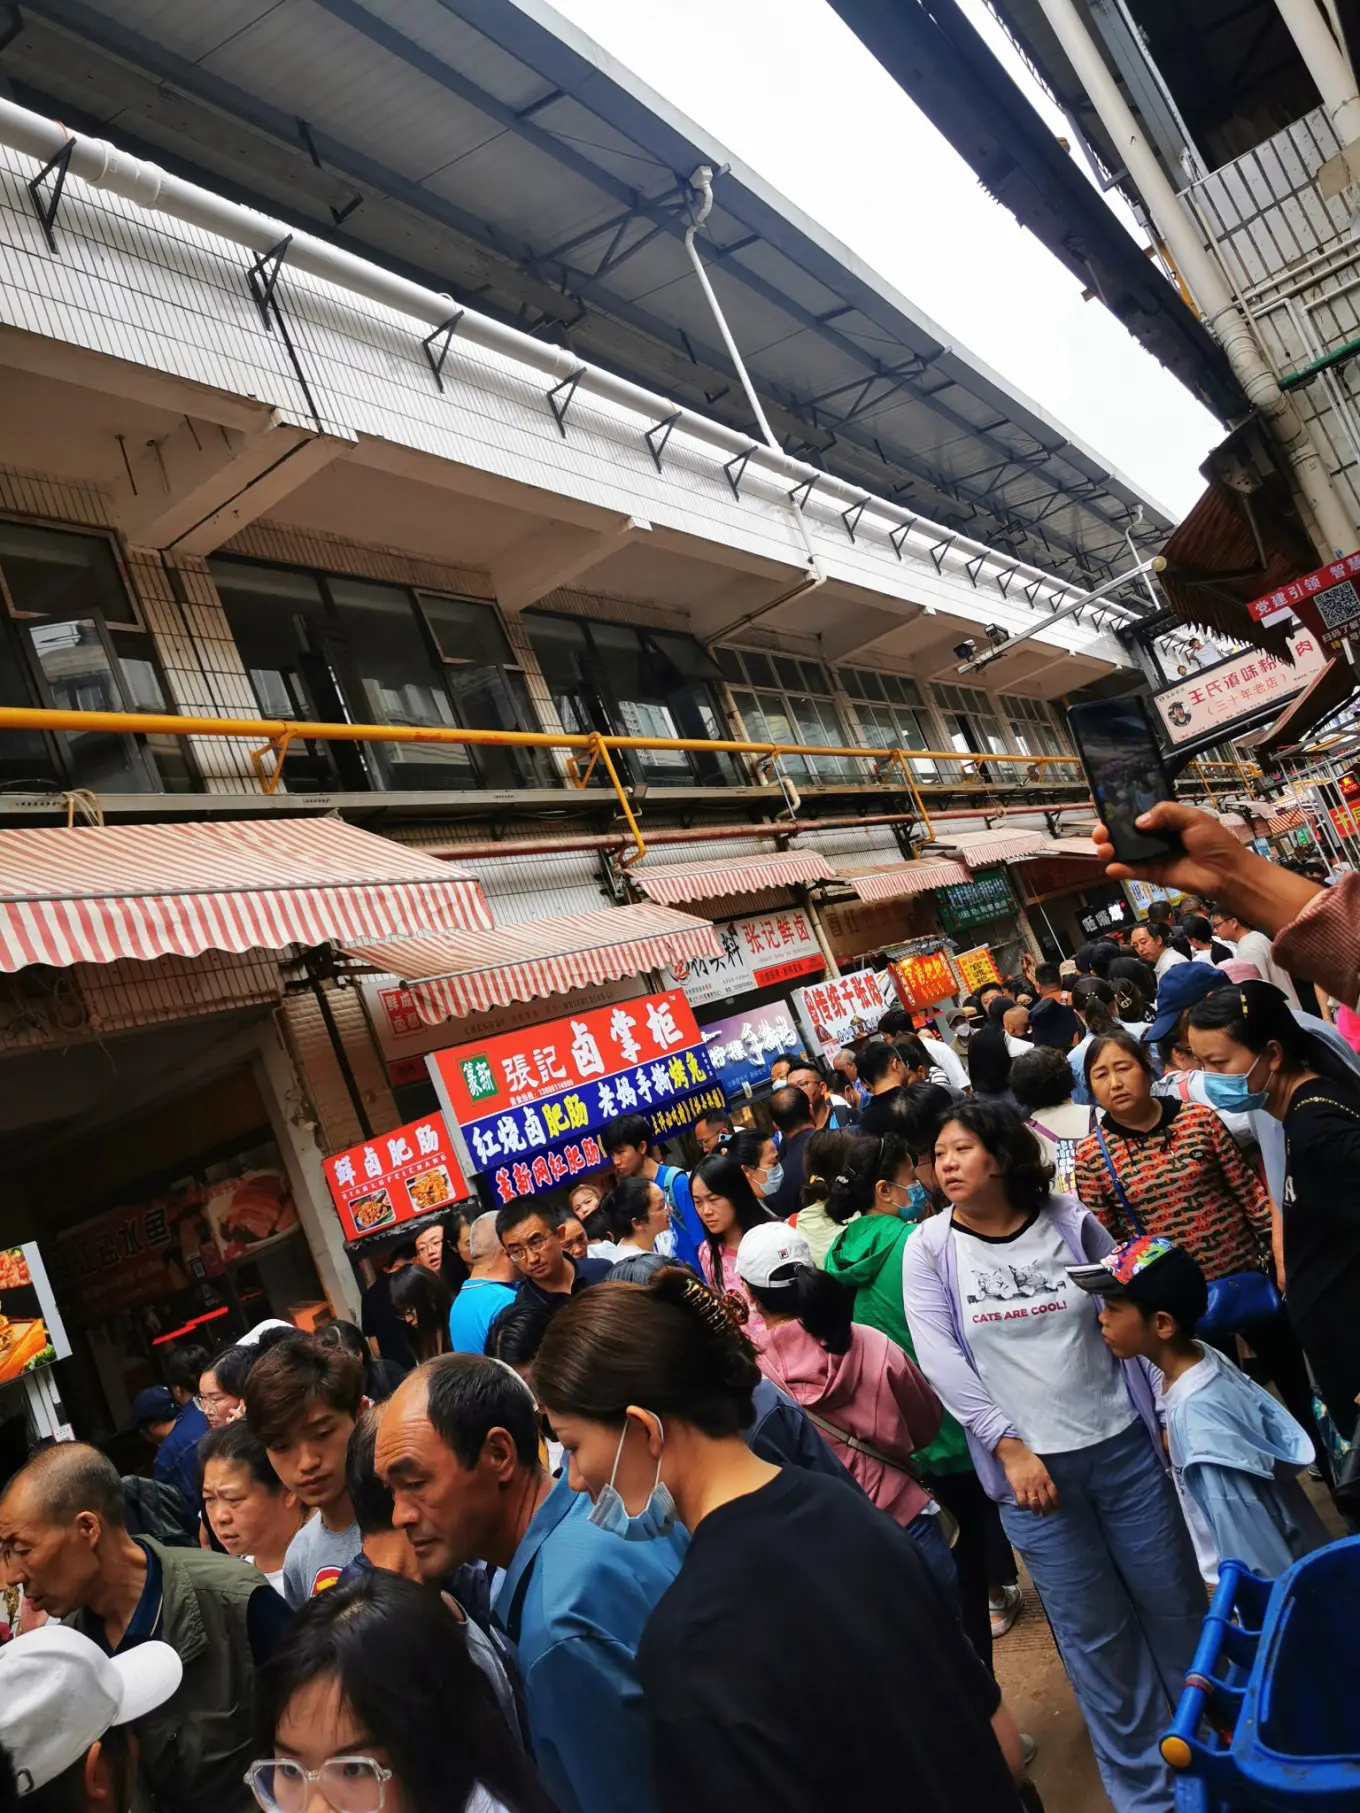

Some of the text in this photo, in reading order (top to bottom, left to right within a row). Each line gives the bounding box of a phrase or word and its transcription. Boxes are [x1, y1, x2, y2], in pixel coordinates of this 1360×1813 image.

[1255, 575, 1321, 616] 党建引领
[1188, 640, 1314, 706] 王氏滇味粉肉
[741, 912, 811, 954] 张记鲜卤
[334, 1123, 439, 1187] 鲜卤肥肠
[472, 1093, 589, 1165] 红烧卤肥肠
[972, 1300, 1068, 1324] CATS ARE COOL!
